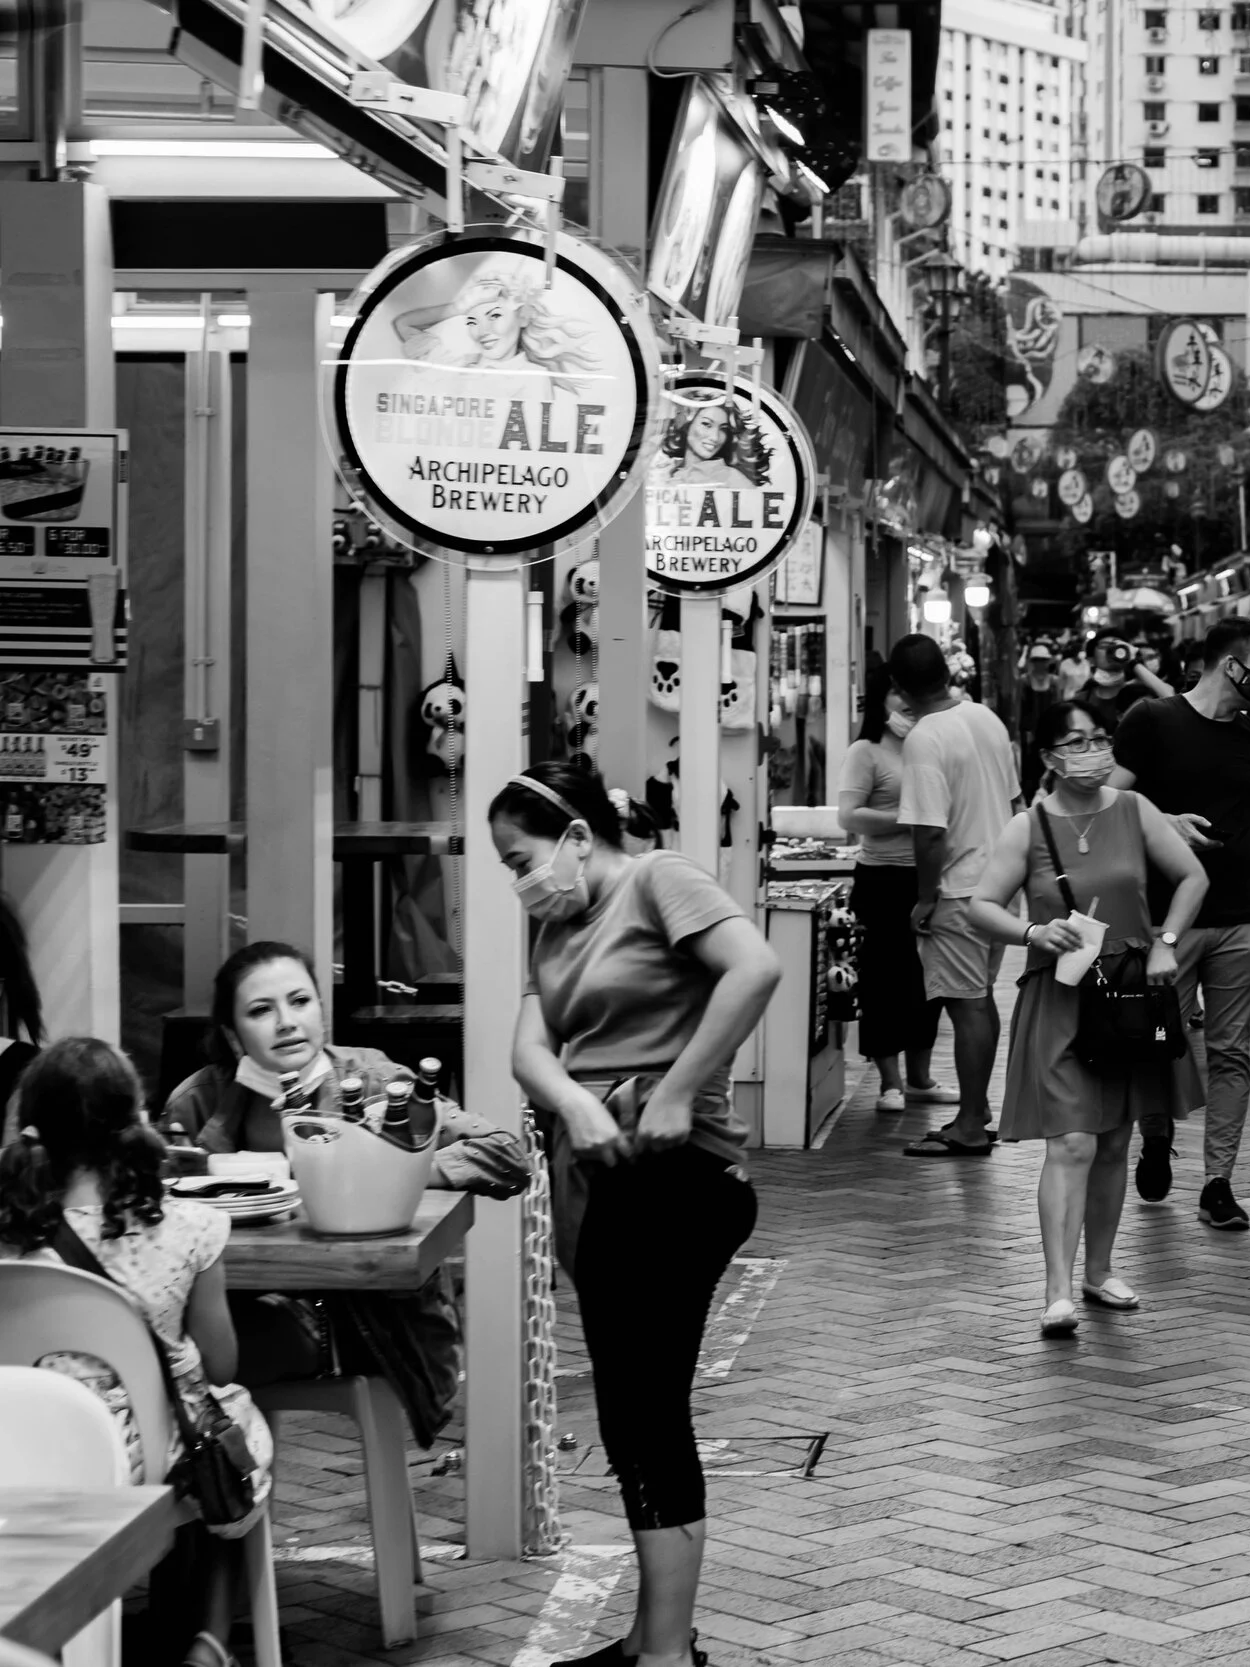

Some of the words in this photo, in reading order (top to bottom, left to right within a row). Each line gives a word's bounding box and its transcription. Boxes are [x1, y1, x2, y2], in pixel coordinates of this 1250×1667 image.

[376, 392, 495, 418] SINGAPORE
[498, 400, 606, 455] ALE
[408, 456, 568, 488] ARCHIPELAGO
[432, 484, 547, 513] BREWERY
[697, 490, 785, 529] ALE
[656, 553, 742, 572] BREWERY
